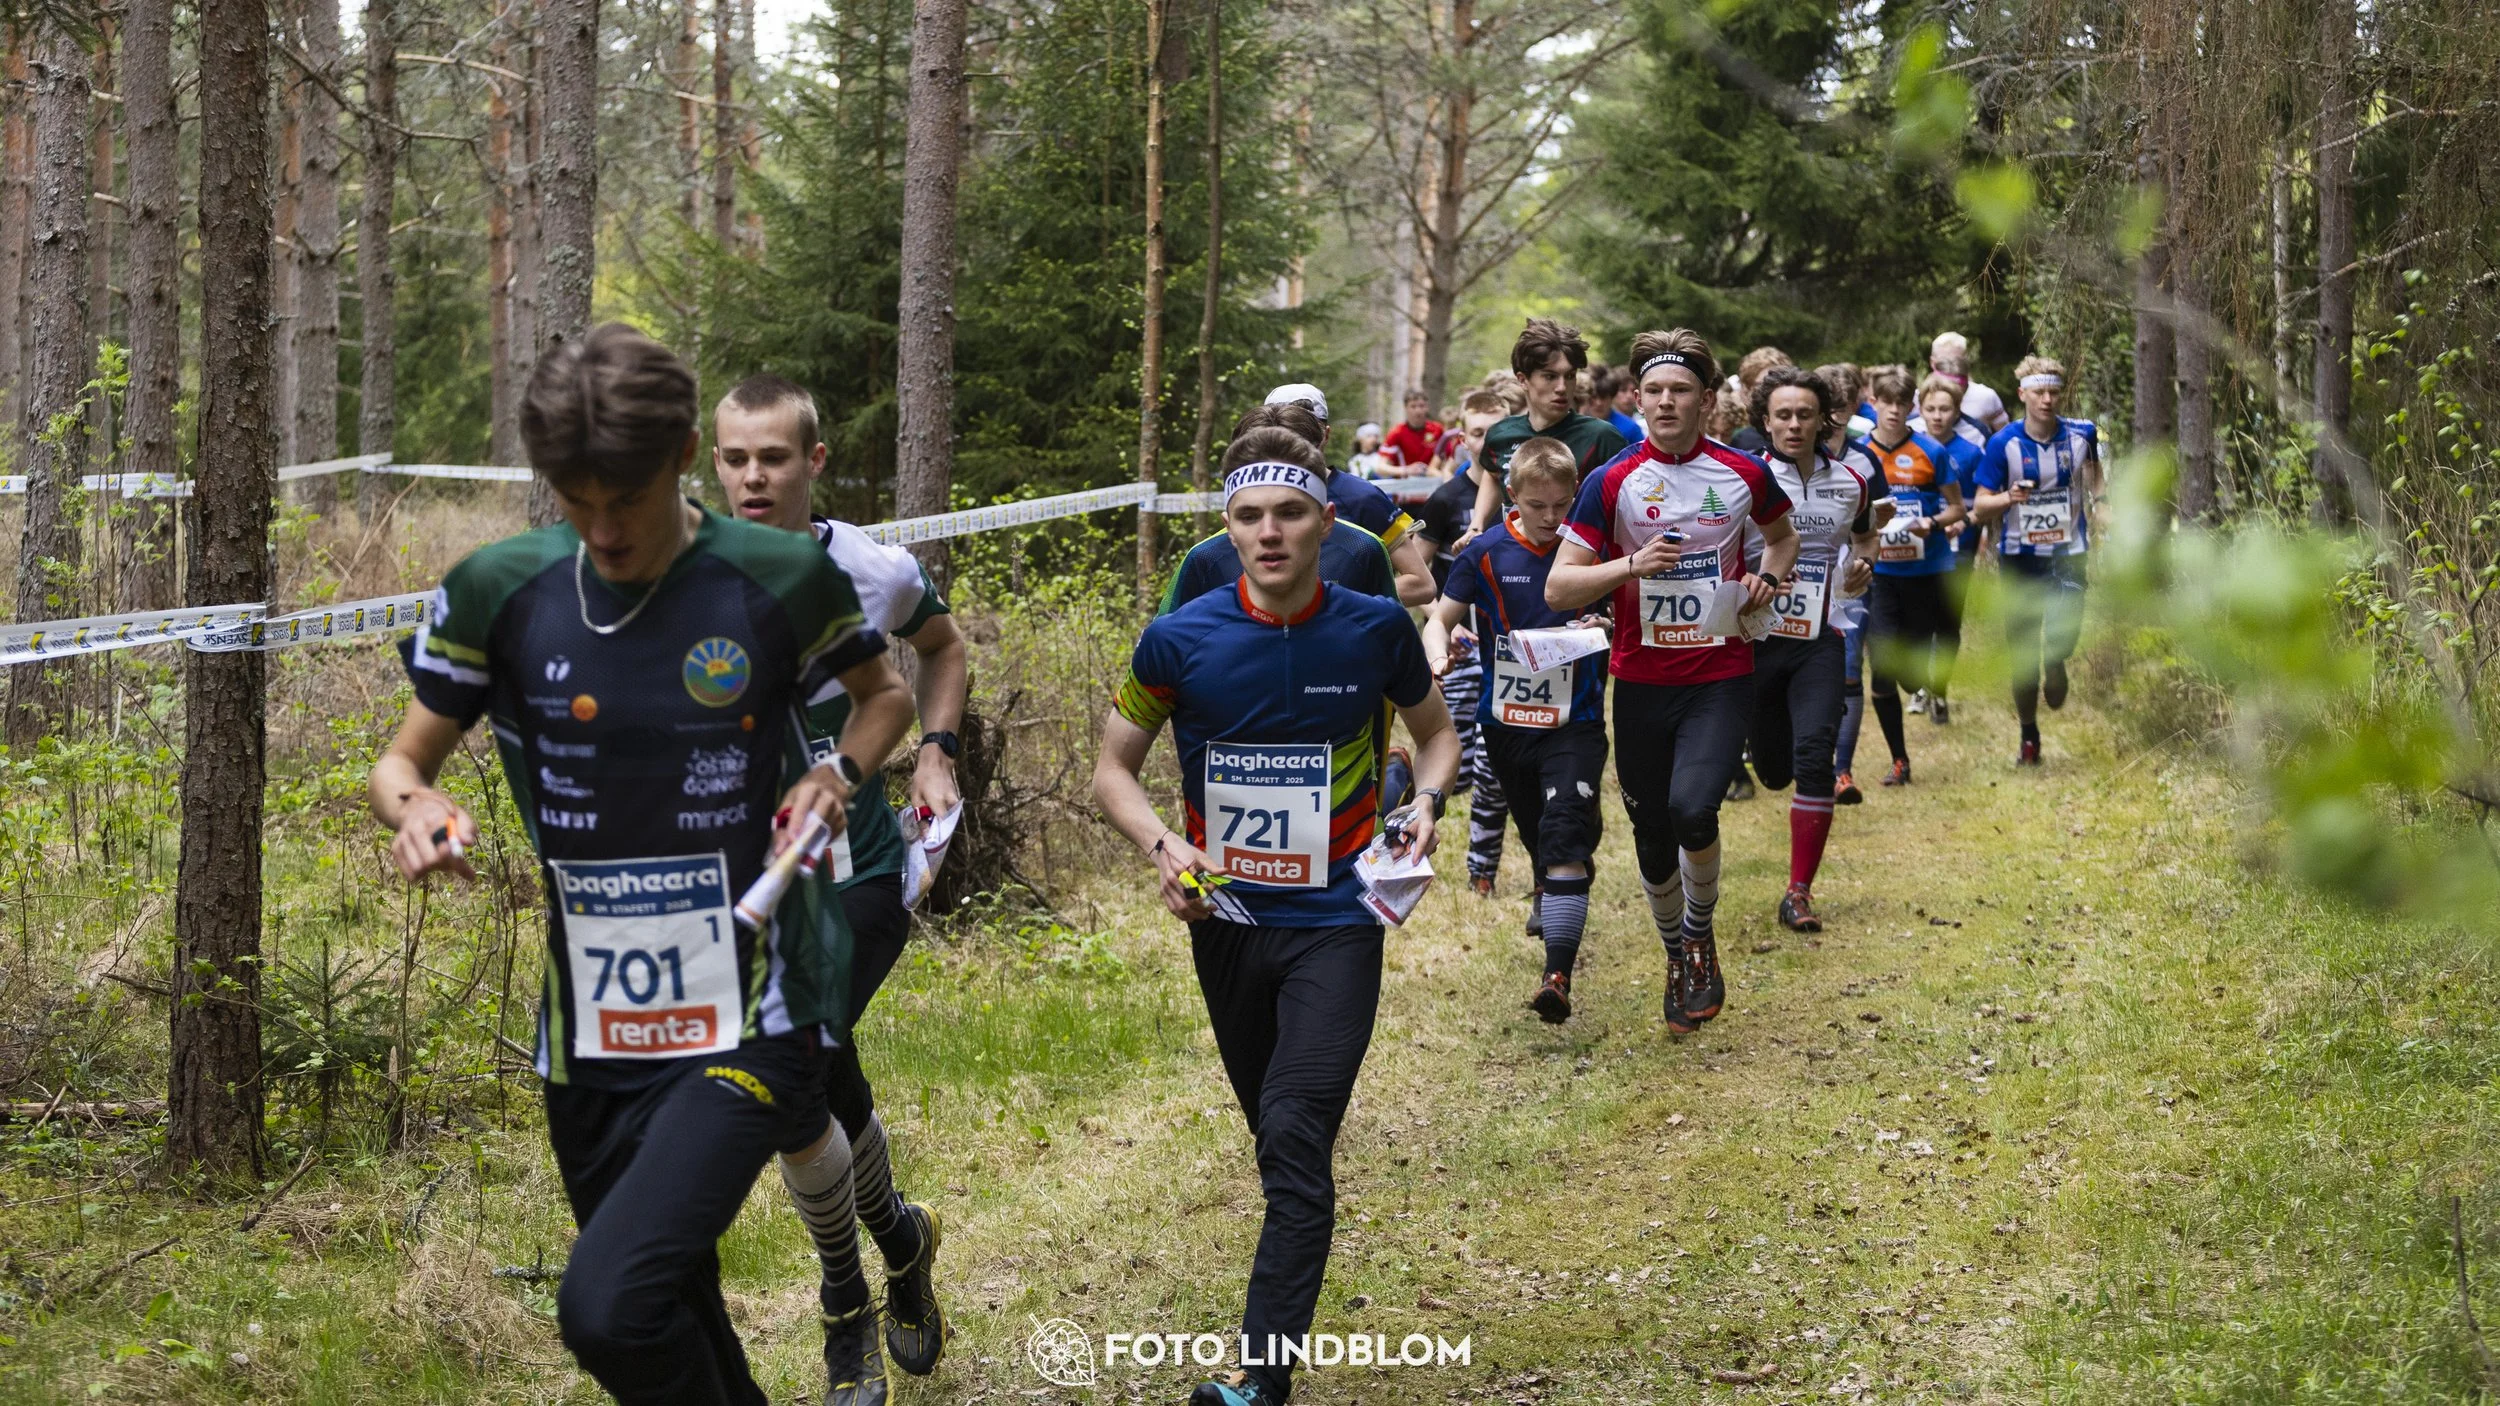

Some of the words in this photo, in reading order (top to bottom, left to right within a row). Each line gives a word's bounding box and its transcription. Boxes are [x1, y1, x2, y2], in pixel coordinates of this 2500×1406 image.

[1227, 465, 1310, 495] TRIMTEX
[2023, 514, 2058, 529] 720
[1710, 580, 1717, 591] 1
[1815, 585, 1820, 597] 1
[1647, 595, 1701, 622] 710
[1774, 593, 1807, 616] 05
[203, 633, 247, 645] SVENSK
[1561, 668, 1567, 681] 1
[1304, 685, 1342, 694] Ronneby
[1498, 674, 1552, 704] 754
[1508, 708, 1554, 723] renta
[1210, 750, 1325, 771] bagheera
[1311, 791, 1320, 812] 1
[1219, 805, 1289, 849] 721
[1231, 856, 1302, 879] renta
[563, 868, 719, 899] bagheera
[611, 903, 657, 914] STAFETT
[704, 915, 720, 944] 1
[584, 945, 685, 1004] 701
[608, 1016, 708, 1045] renta
